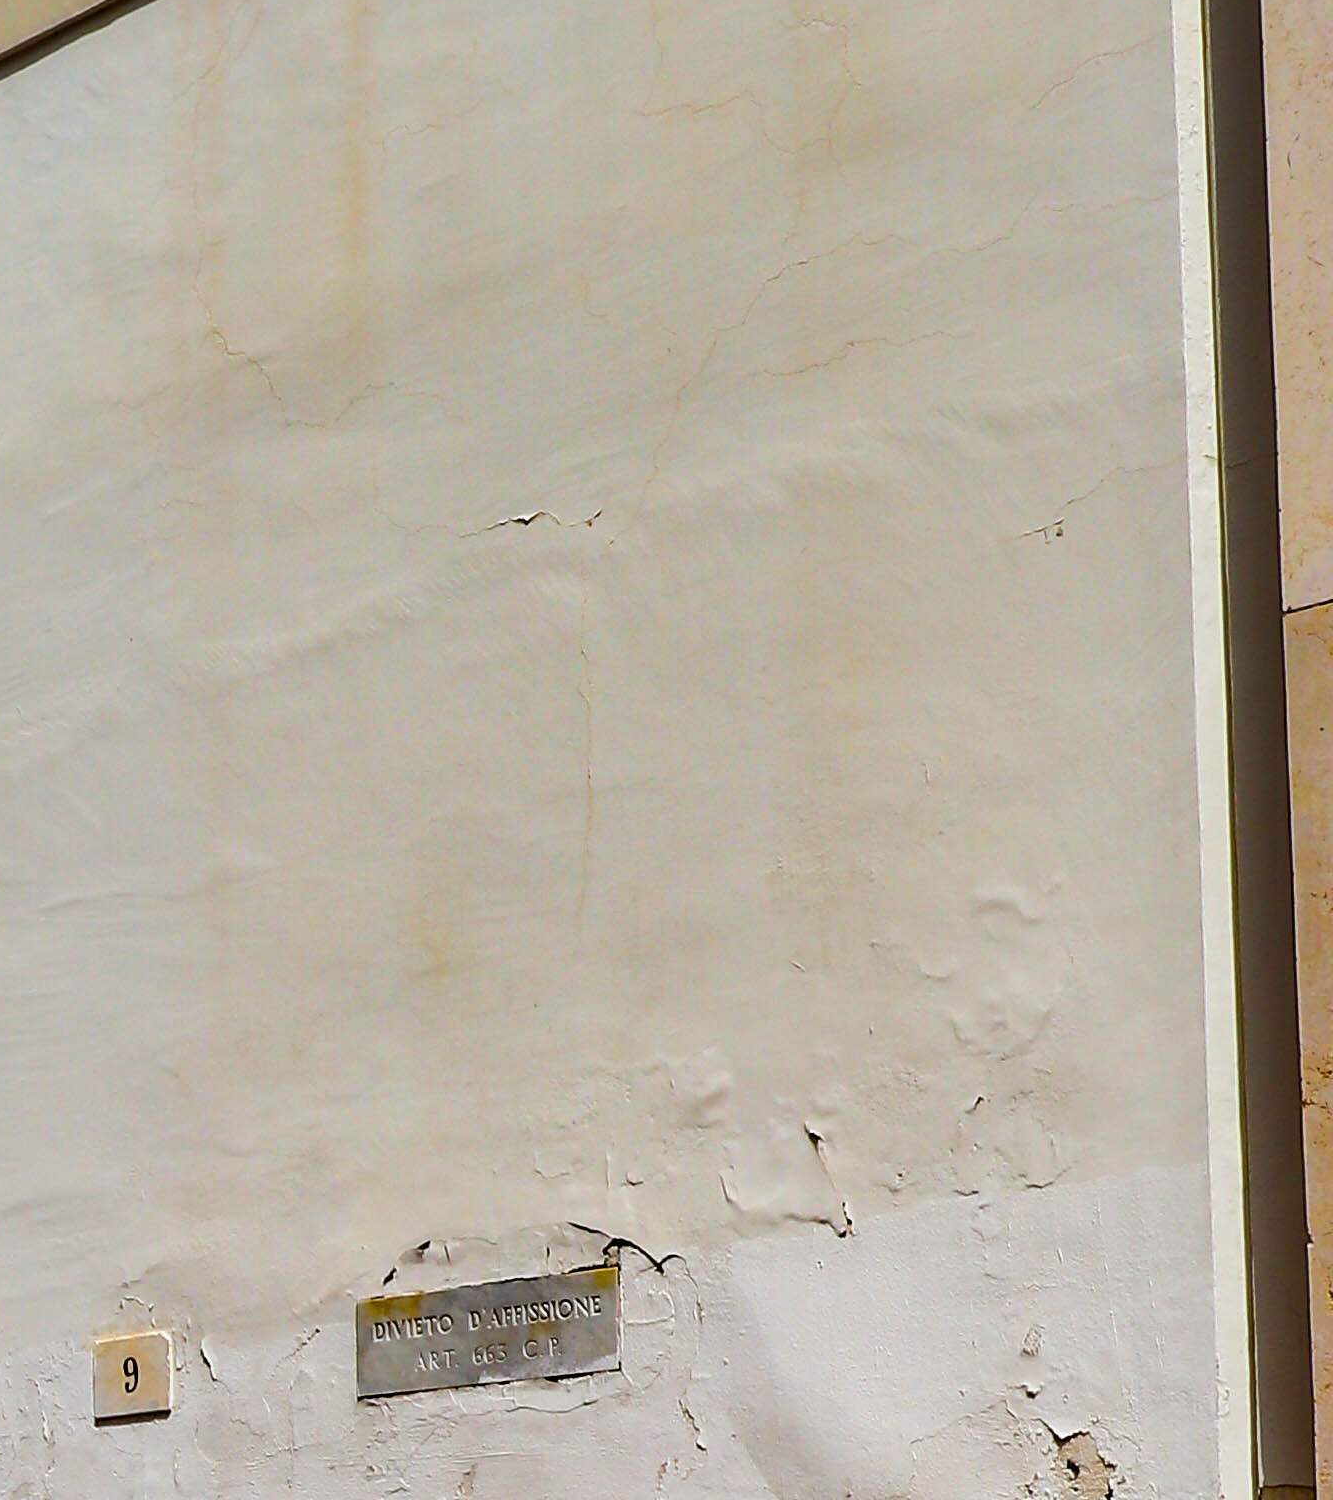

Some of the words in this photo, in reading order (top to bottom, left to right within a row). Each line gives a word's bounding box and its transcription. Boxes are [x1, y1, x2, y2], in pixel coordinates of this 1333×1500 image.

[372, 1315, 454, 1344] DIVIETO
[468, 1295, 602, 1333] D'AFFISSIONE
[122, 1355, 139, 1393] 9
[414, 1349, 459, 1373] ART.
[472, 1343, 508, 1367] 663
